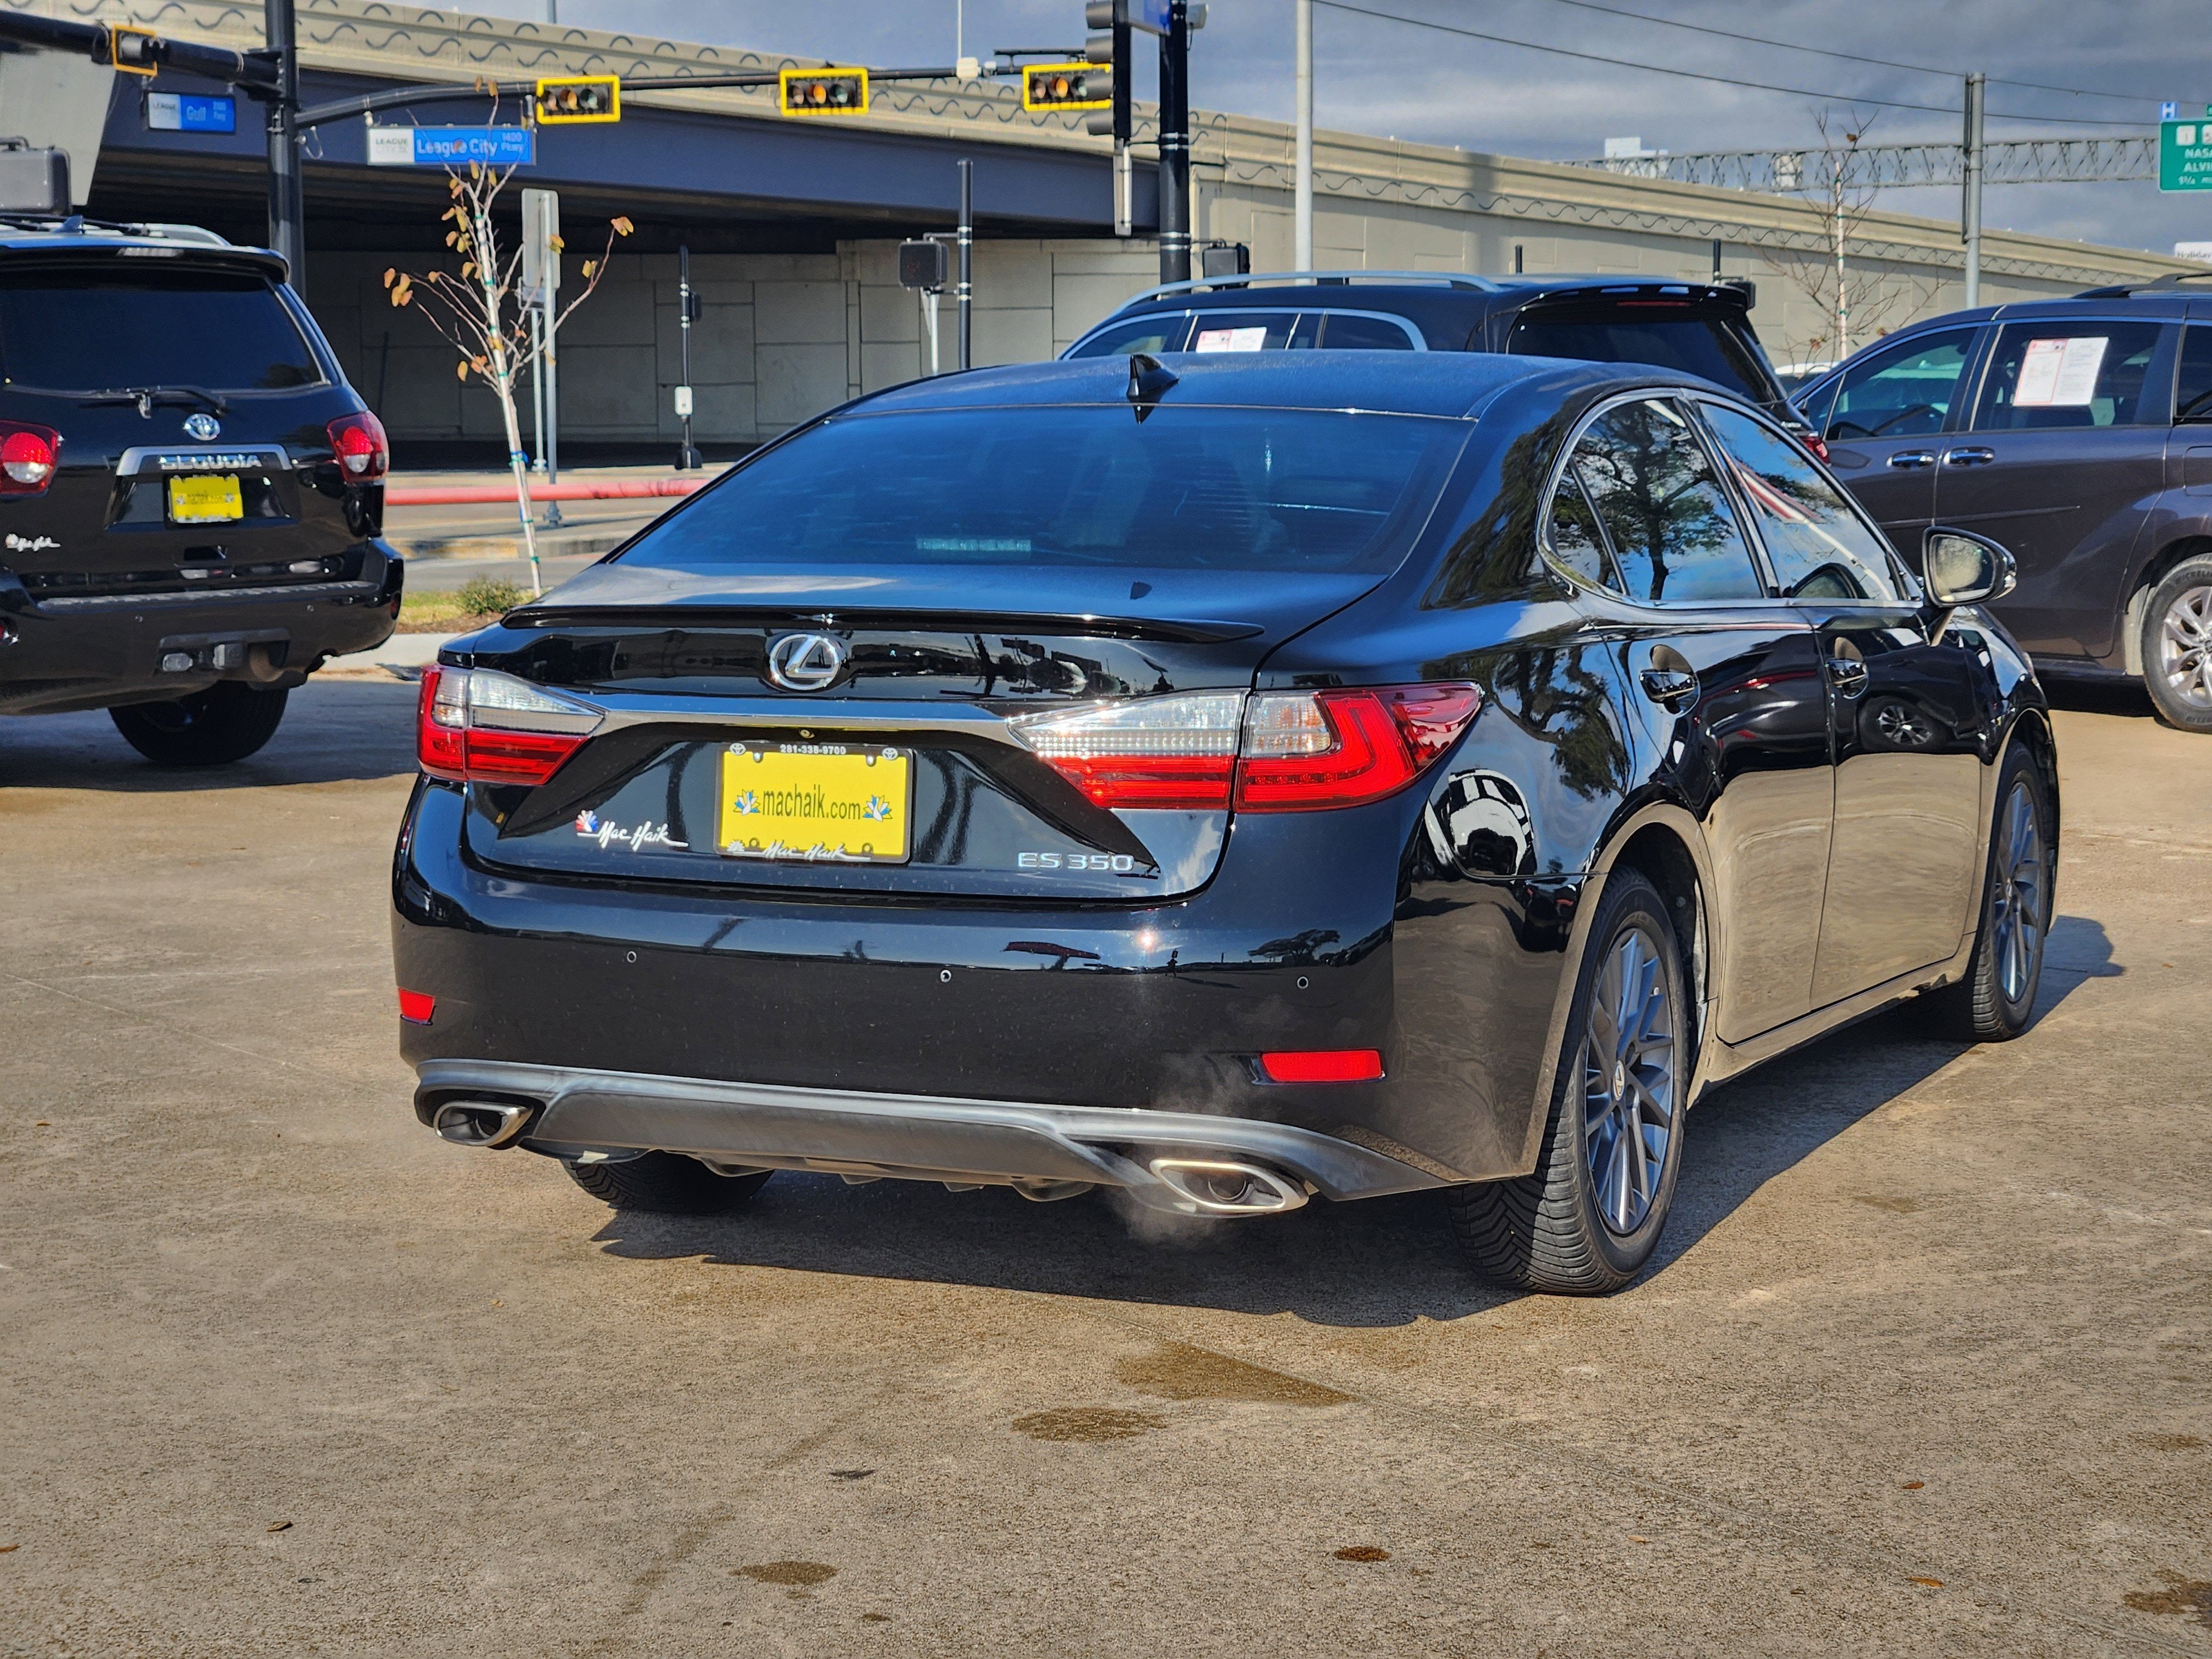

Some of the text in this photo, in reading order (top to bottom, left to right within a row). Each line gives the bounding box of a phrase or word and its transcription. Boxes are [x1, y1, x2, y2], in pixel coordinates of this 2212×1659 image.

[416, 138, 498, 158] League City
[159, 453, 263, 469] SEQUOIA
[779, 743, 847, 755] 281-338-9700
[762, 783, 861, 820] machaik.com
[598, 820, 689, 852] Mac Haik
[764, 839, 871, 862] Mac Haik
[1018, 852, 1134, 871] ES 350
